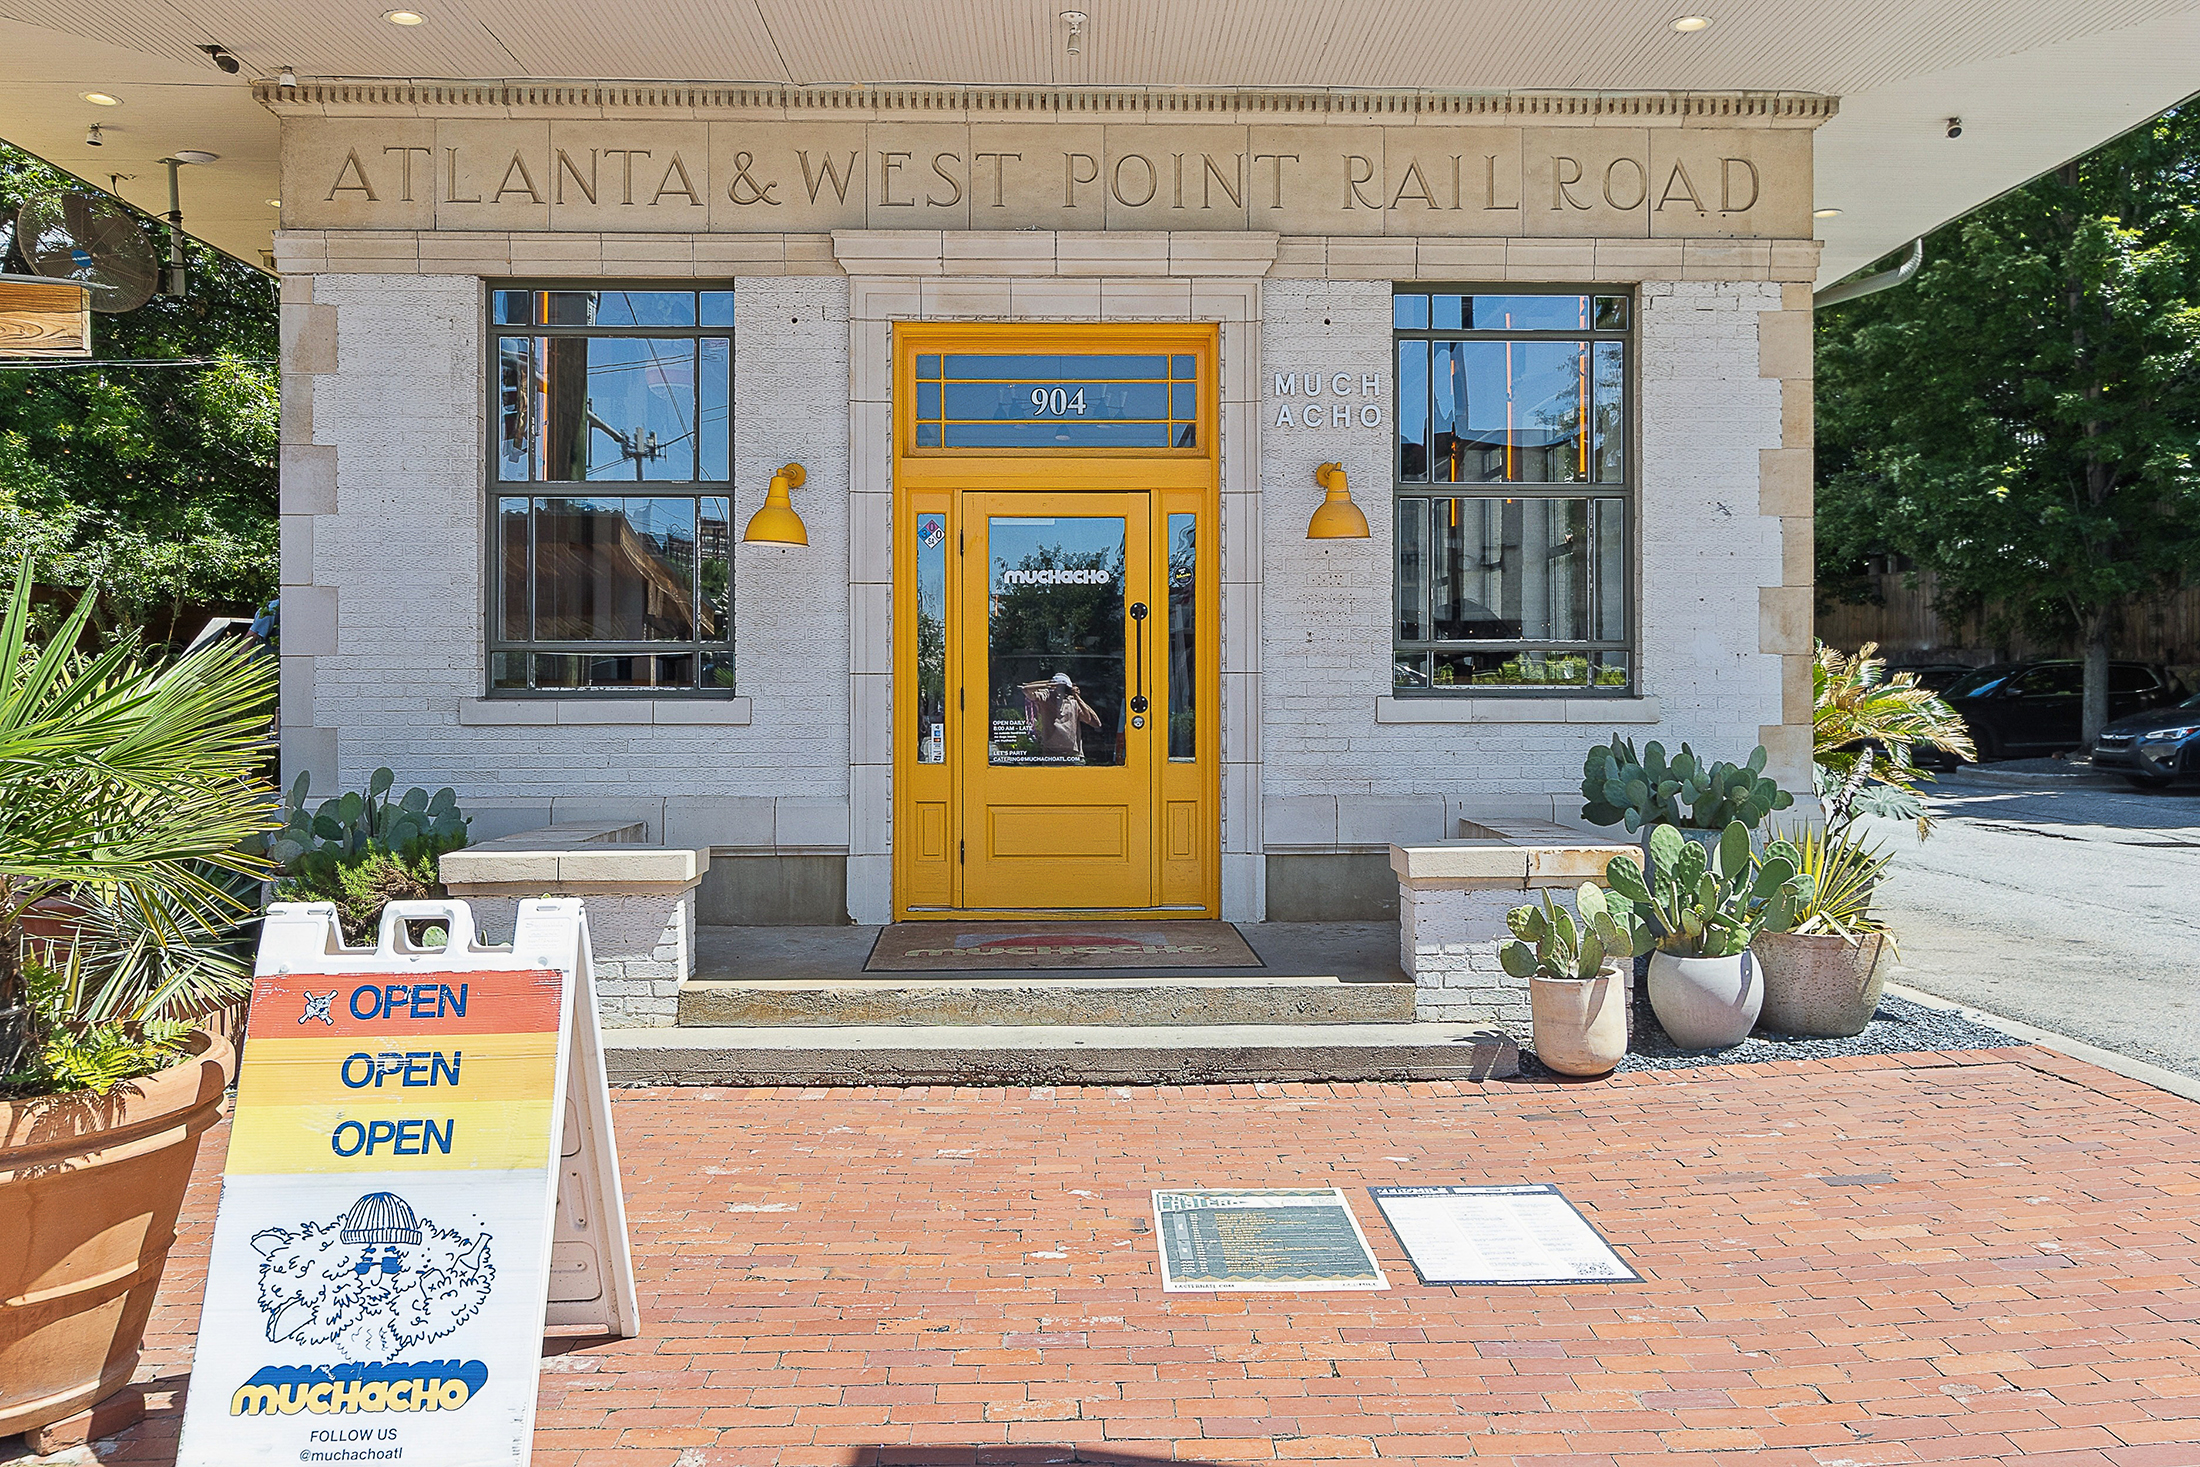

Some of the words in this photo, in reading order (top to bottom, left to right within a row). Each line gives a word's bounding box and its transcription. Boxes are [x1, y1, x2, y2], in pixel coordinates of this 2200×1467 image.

[322, 145, 705, 207] ATLANTA
[726, 149, 782, 207] &
[796, 148, 1023, 208] WEST
[1062, 151, 1300, 210] POINT
[1274, 371, 1381, 397] MUCH
[1030, 386, 1087, 417] 904
[1275, 403, 1383, 429] ACHO
[350, 983, 469, 1021] OPEN
[340, 1051, 462, 1089] OPEN
[331, 1119, 455, 1158] OPEN
[310, 1429, 373, 1443] FOLLOW
[377, 1428, 398, 1441] US
[299, 1447, 403, 1462] @muchachoatl
